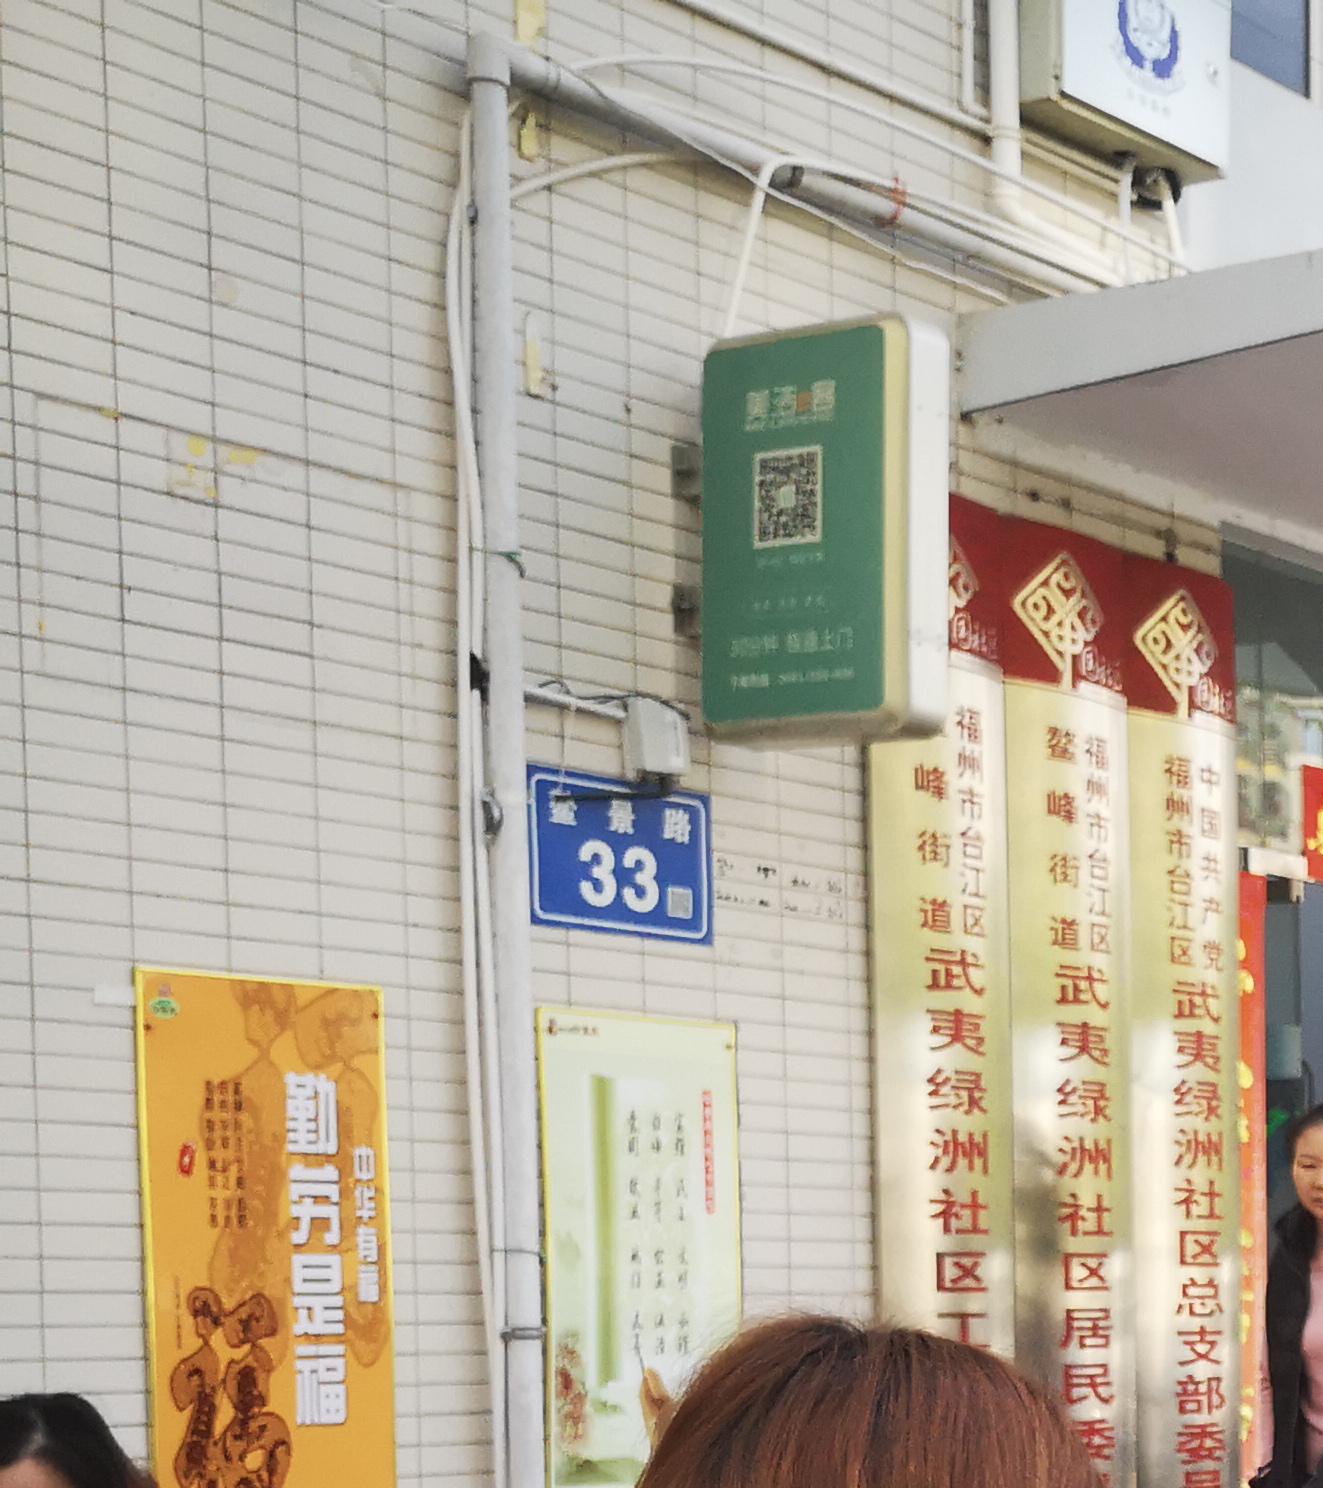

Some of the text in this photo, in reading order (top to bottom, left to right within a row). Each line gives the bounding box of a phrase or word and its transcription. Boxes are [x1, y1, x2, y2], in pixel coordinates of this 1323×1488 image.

[578, 838, 661, 914] 33
[954, 706, 988, 939] 福州市台江区
[1046, 725, 1081, 952] 鳌峰街道
[1083, 735, 1114, 954] 福州市台江区
[1162, 754, 1196, 966] 福州市台江区
[1198, 762, 1224, 974] 中国共产党
[1053, 964, 1116, 1484] 武夷绿洲社区居民委
